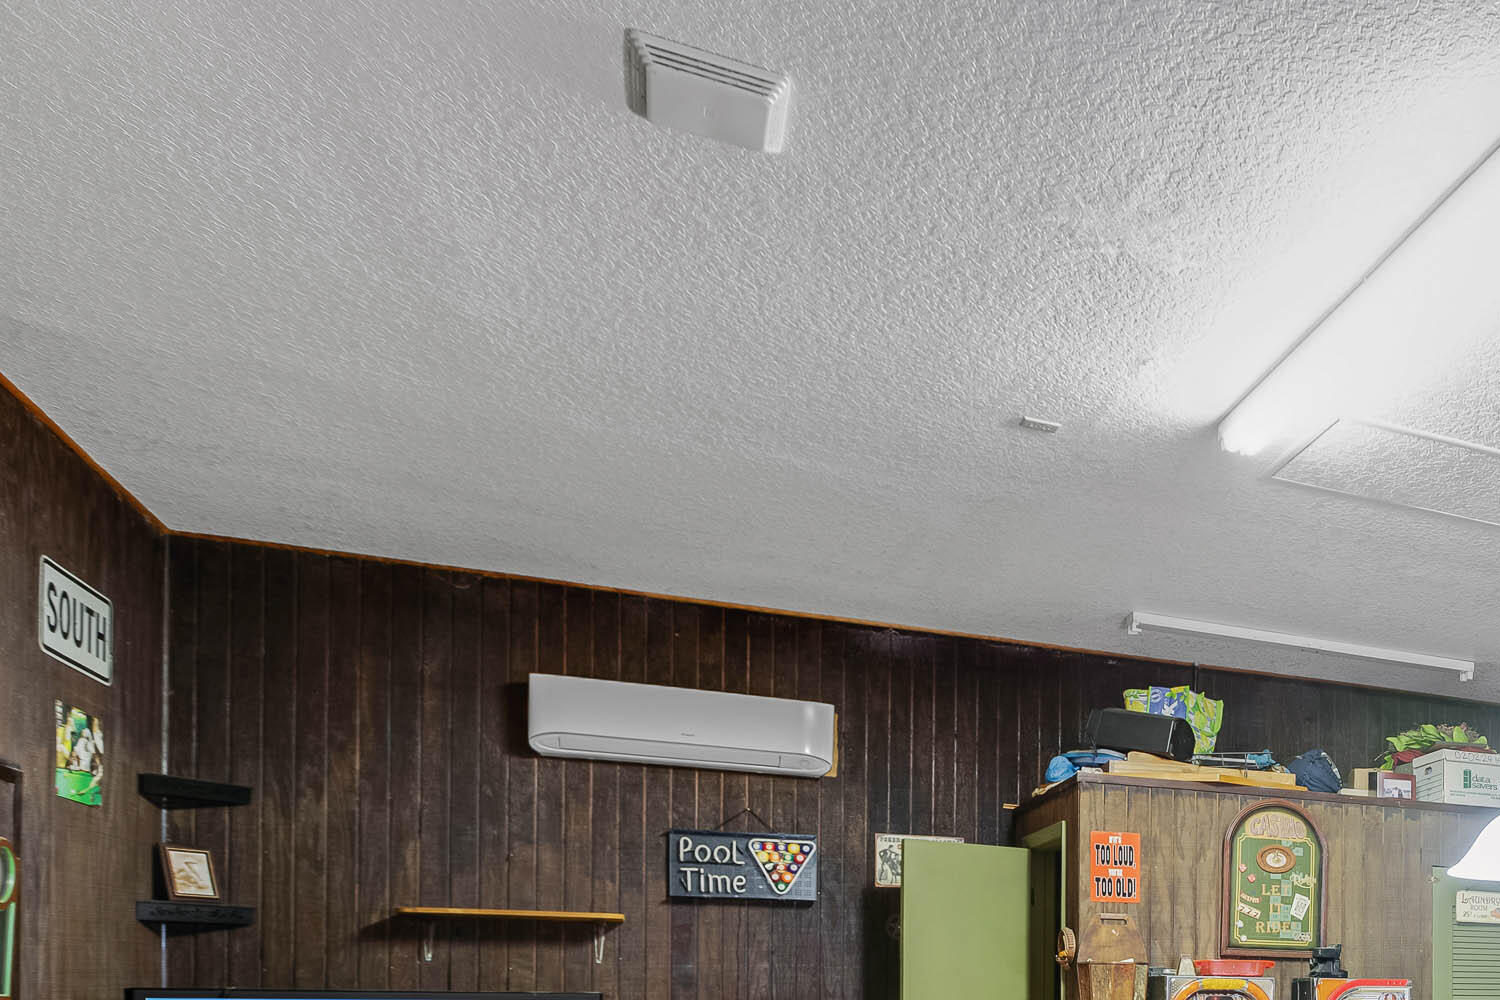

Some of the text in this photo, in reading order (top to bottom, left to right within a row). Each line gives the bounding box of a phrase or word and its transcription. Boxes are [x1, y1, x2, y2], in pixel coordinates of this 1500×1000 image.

[46, 581, 107, 663] SOUTH
[1472, 782, 1498, 791] savers
[1095, 843, 1136, 869] TOO LOUD,
[679, 867, 747, 893] Time
[1095, 876, 1136, 898] TOO OLD!
[1261, 883, 1290, 896] LET
